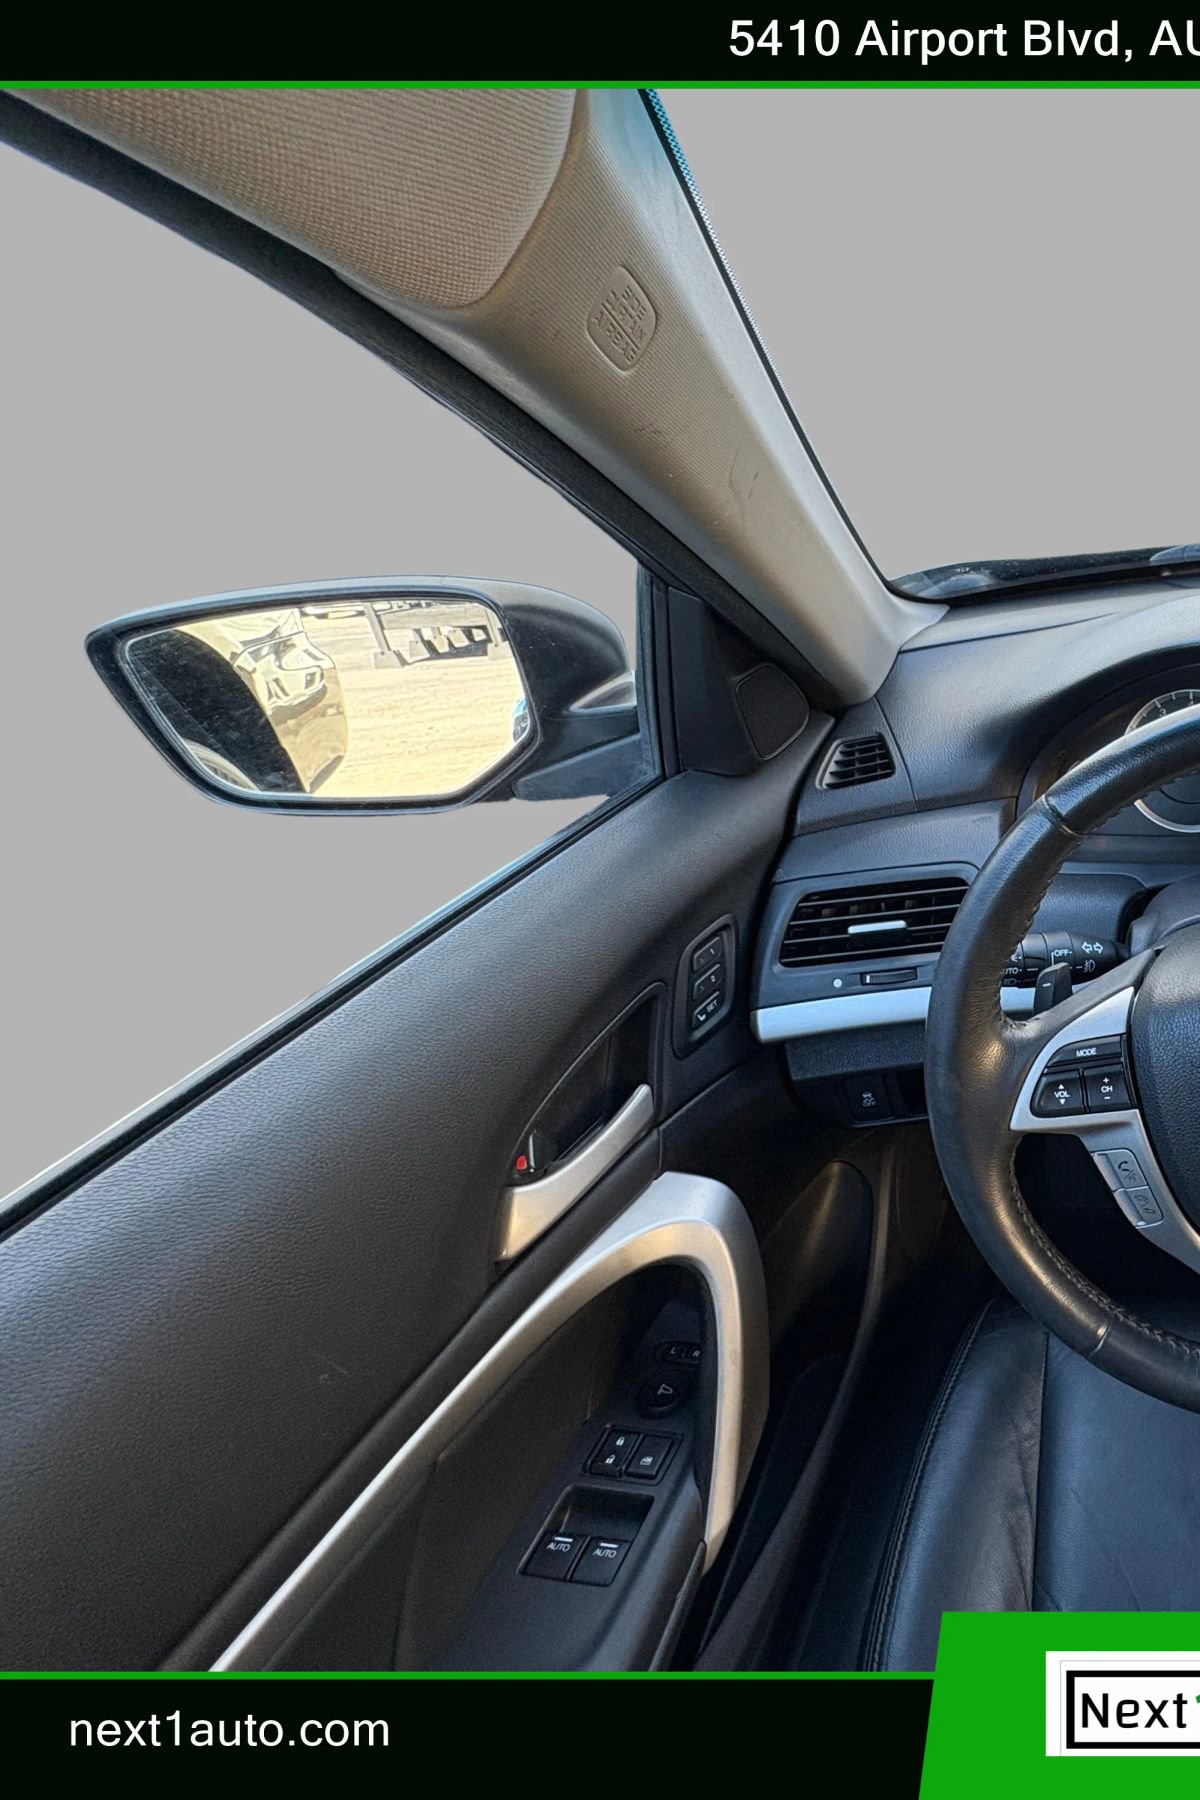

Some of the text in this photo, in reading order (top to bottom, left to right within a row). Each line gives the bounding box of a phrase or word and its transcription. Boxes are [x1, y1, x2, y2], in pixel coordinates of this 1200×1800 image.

[1054, 949, 1069, 957] OFF
[1076, 1048, 1097, 1057] MODE
[1101, 1085, 1113, 1093] CH
[547, 1542, 571, 1552] AUTO
[592, 1548, 617, 1558] AUTO
